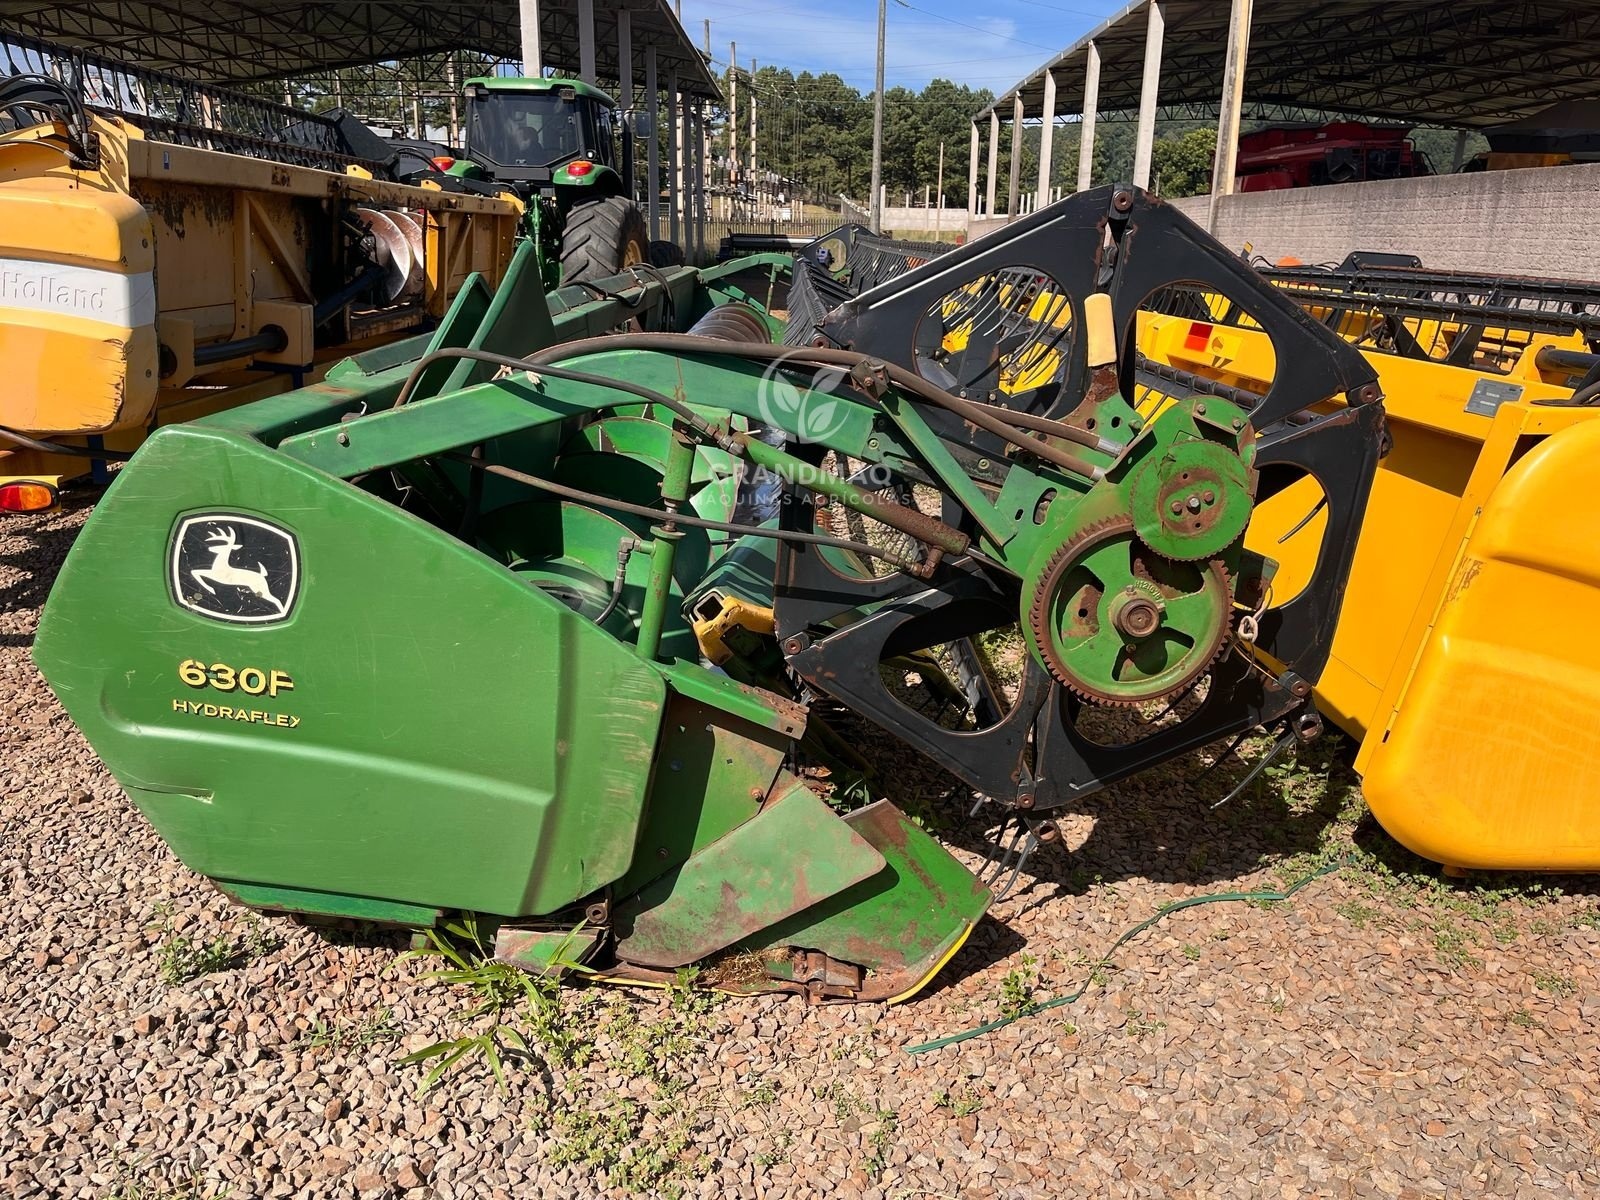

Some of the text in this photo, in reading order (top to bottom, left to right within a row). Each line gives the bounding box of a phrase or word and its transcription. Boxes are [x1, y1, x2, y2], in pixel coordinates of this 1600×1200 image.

[2, 271, 107, 312] Holland
[179, 659, 295, 698] 630F
[172, 699, 301, 728] HYDRAFLEX
